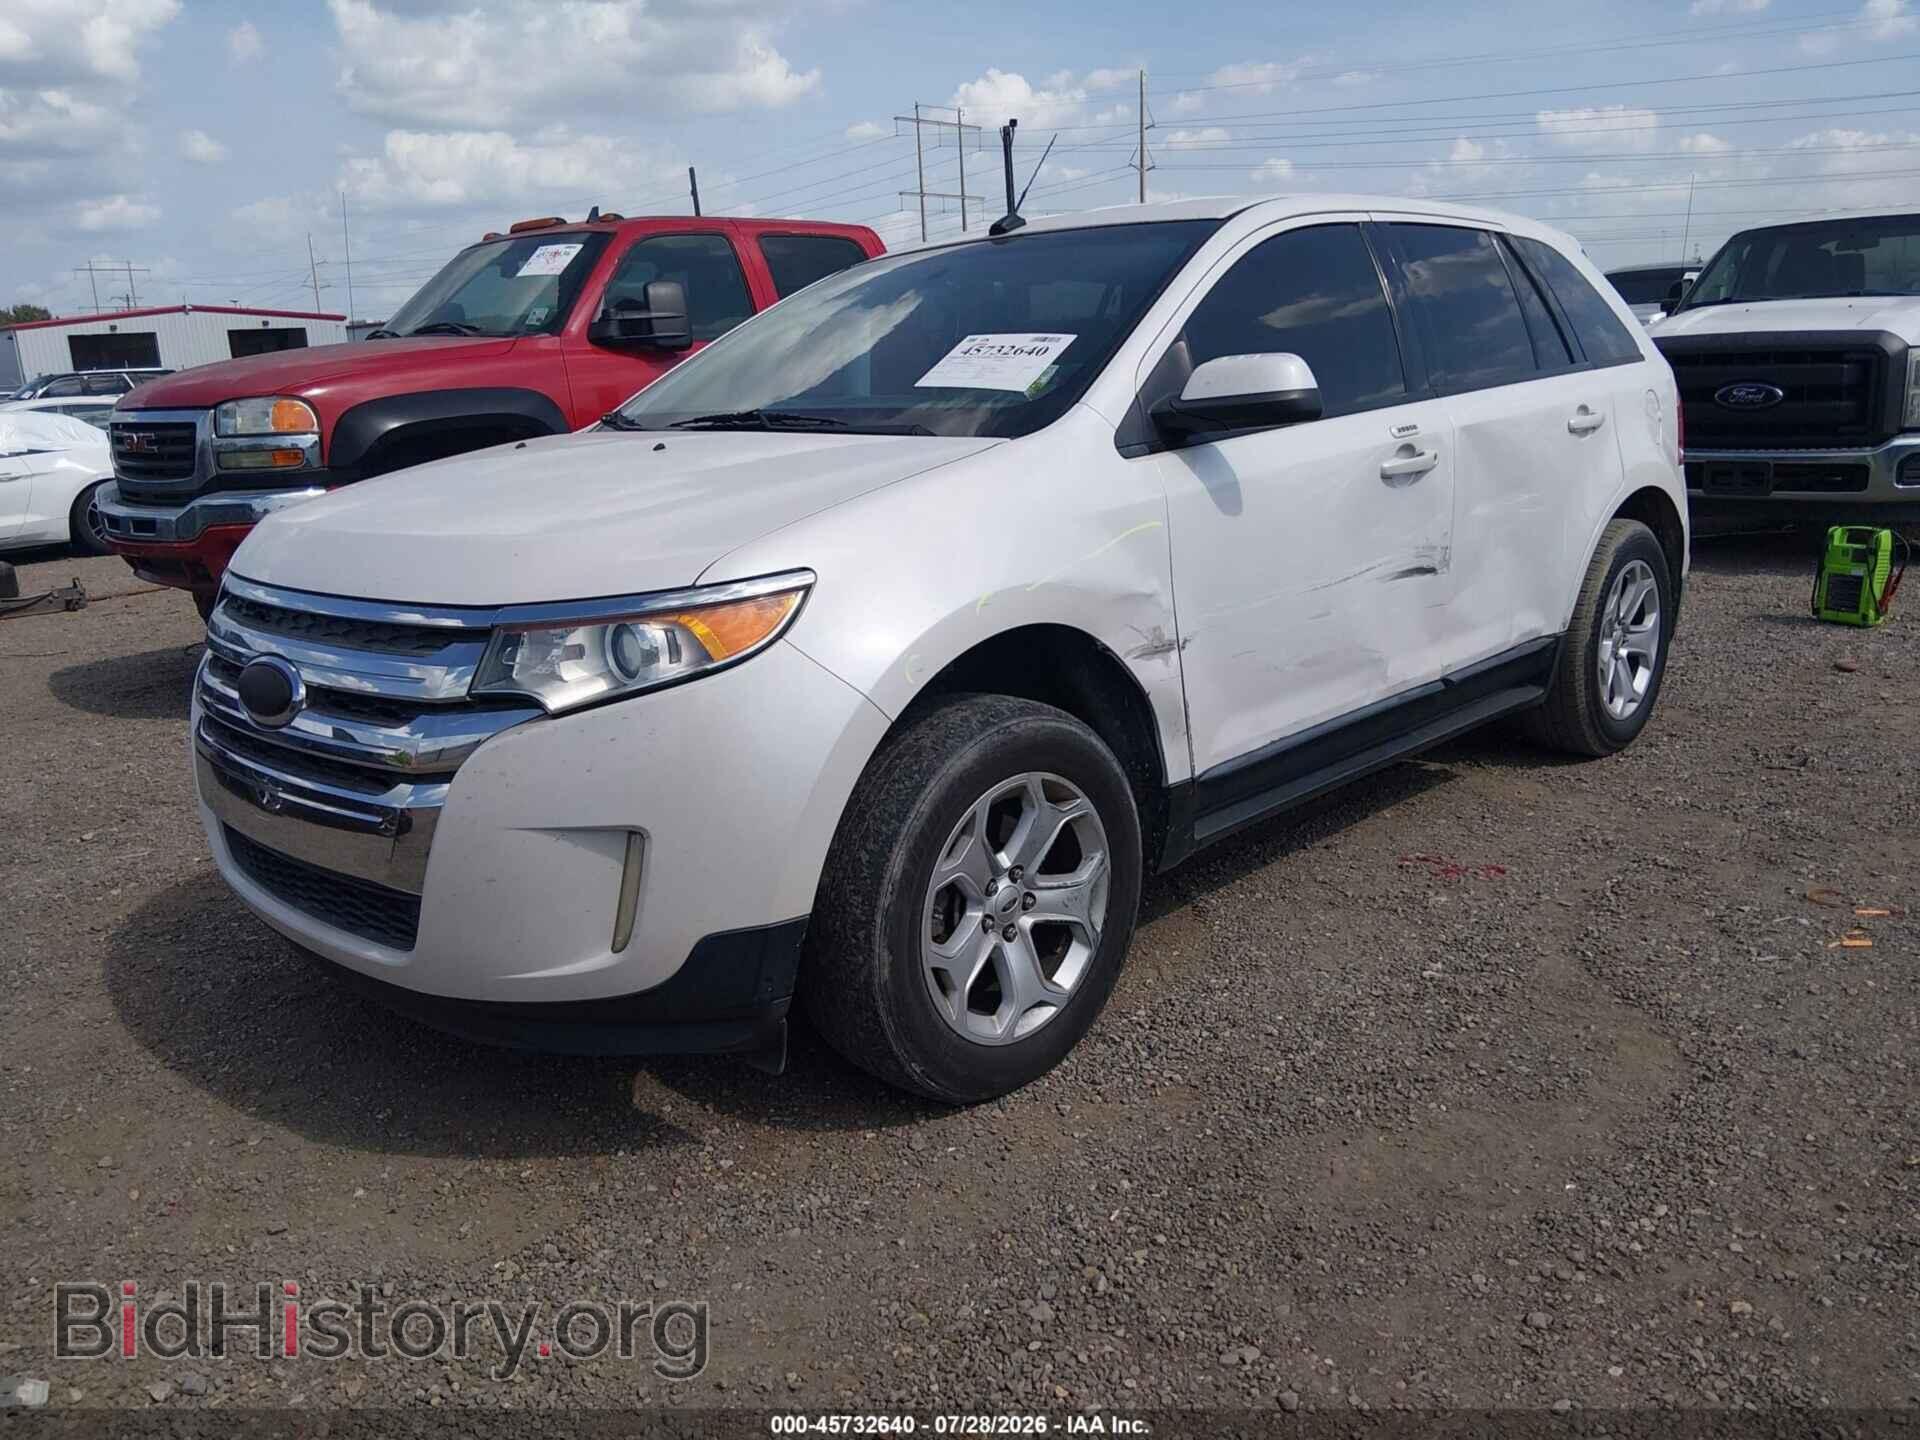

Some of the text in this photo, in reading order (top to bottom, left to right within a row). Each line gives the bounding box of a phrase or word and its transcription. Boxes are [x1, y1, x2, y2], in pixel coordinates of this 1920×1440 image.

[960, 344, 1050, 357] 45732640
[1729, 387, 1767, 403] Ford
[122, 432, 158, 453] GMC
